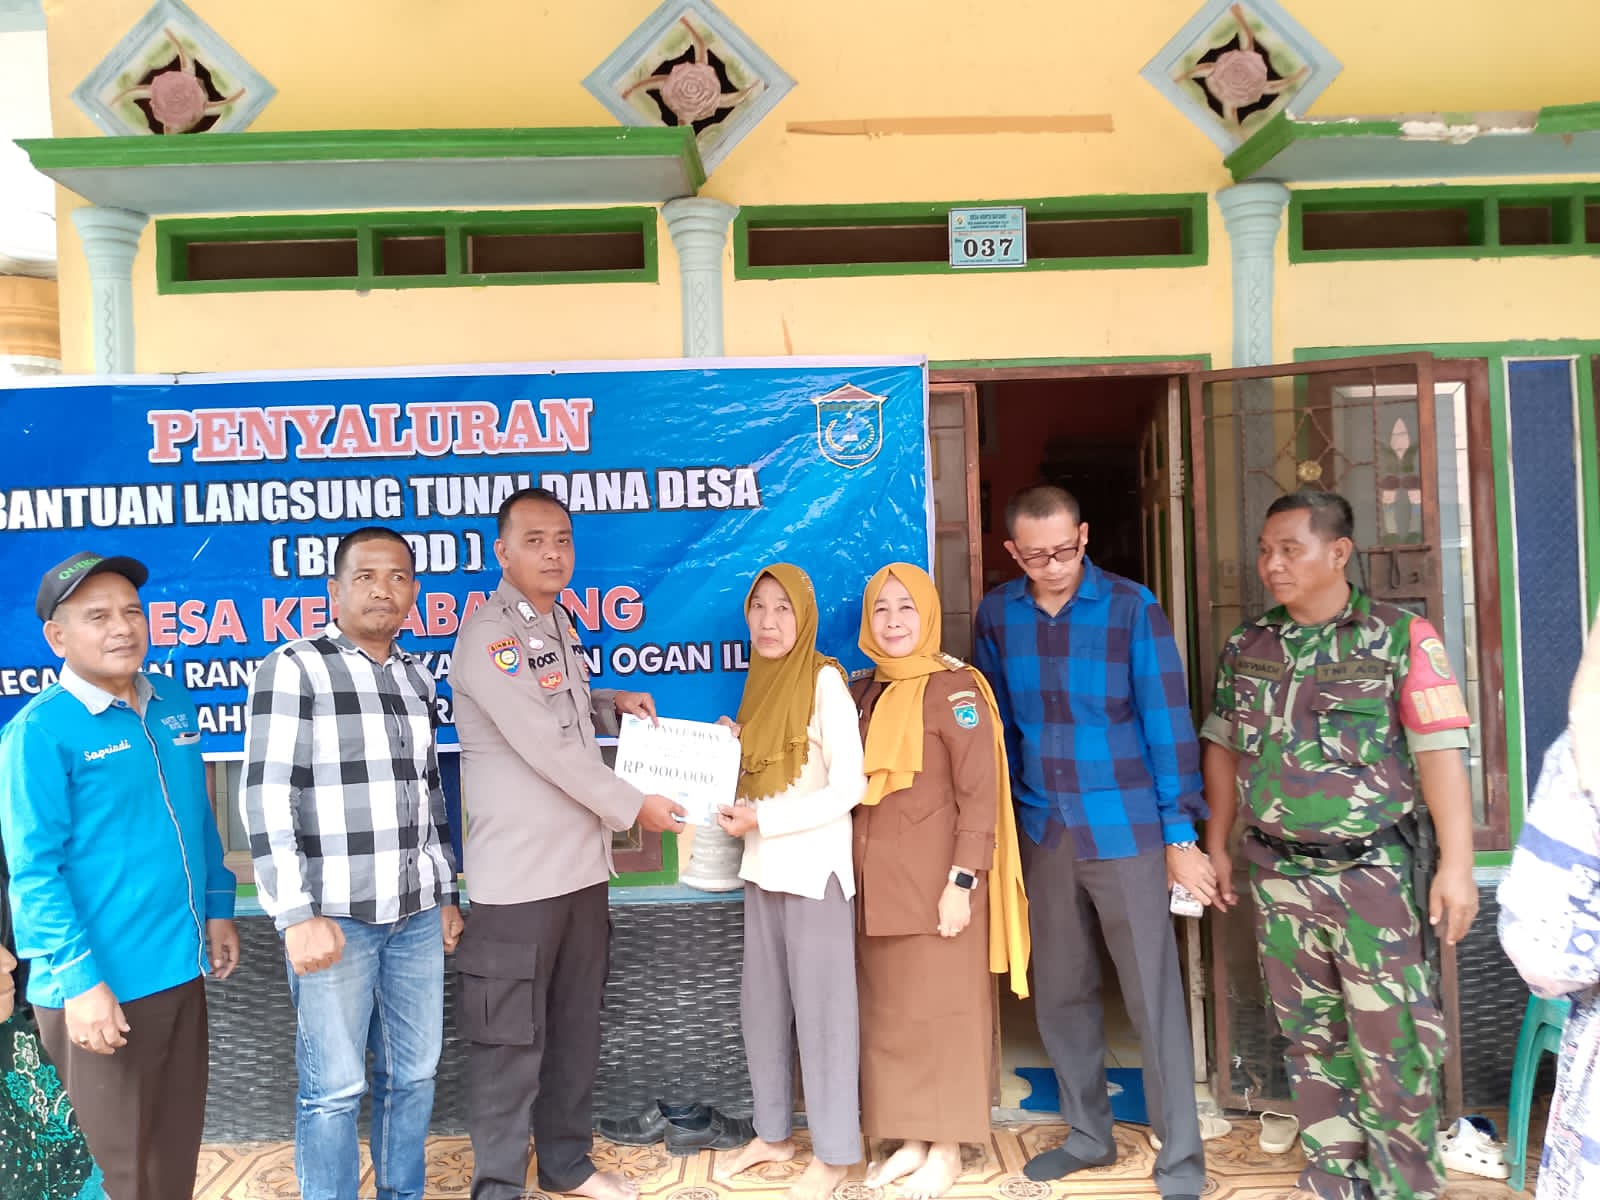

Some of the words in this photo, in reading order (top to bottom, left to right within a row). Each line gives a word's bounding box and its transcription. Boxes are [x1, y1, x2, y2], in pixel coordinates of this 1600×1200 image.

[963, 238, 1014, 258] 037
[148, 401, 593, 463] PENYALURAN
[184, 478, 401, 524] LANGSUNG
[658, 467, 761, 508] DESA
[148, 599, 247, 646] ESA
[611, 644, 712, 674] OGAN
[623, 759, 644, 774] RP
